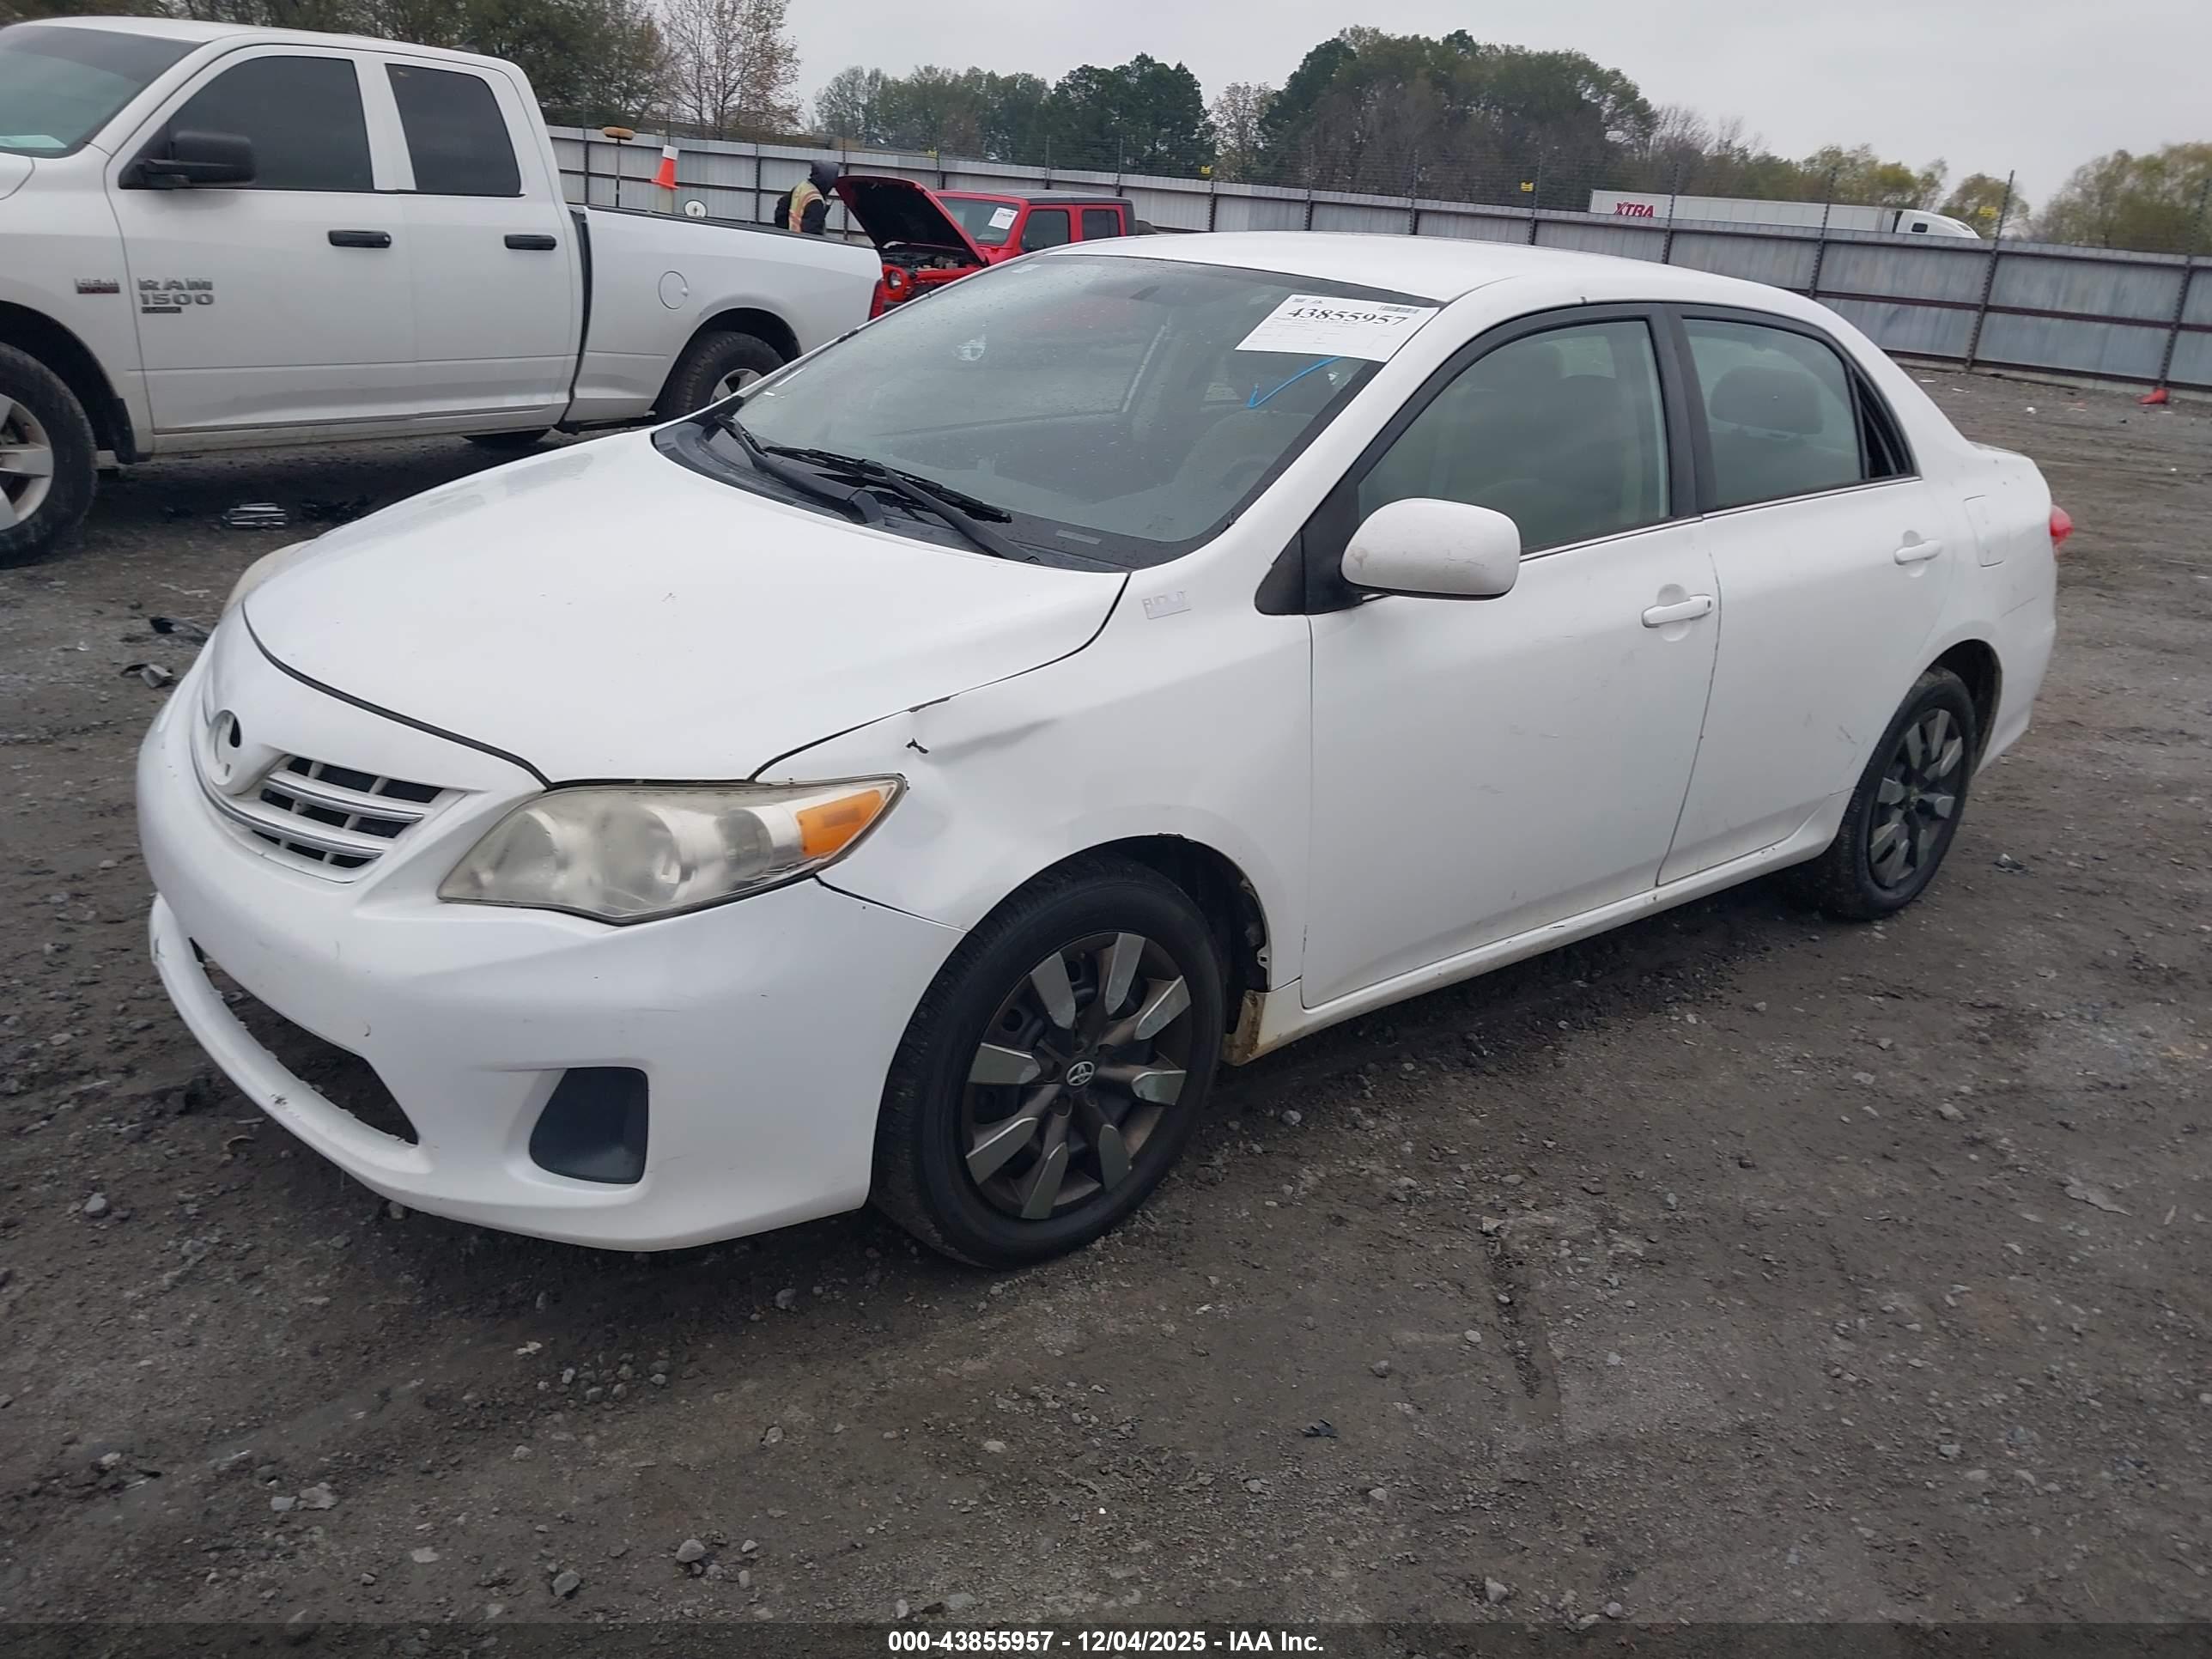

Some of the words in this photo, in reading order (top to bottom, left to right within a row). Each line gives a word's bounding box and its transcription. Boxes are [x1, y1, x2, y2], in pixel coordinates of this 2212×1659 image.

[1614, 202, 1654, 217] XTRA
[138, 278, 213, 290] RAM
[139, 293, 214, 305] 1500
[1287, 307, 1408, 325] 43855957
